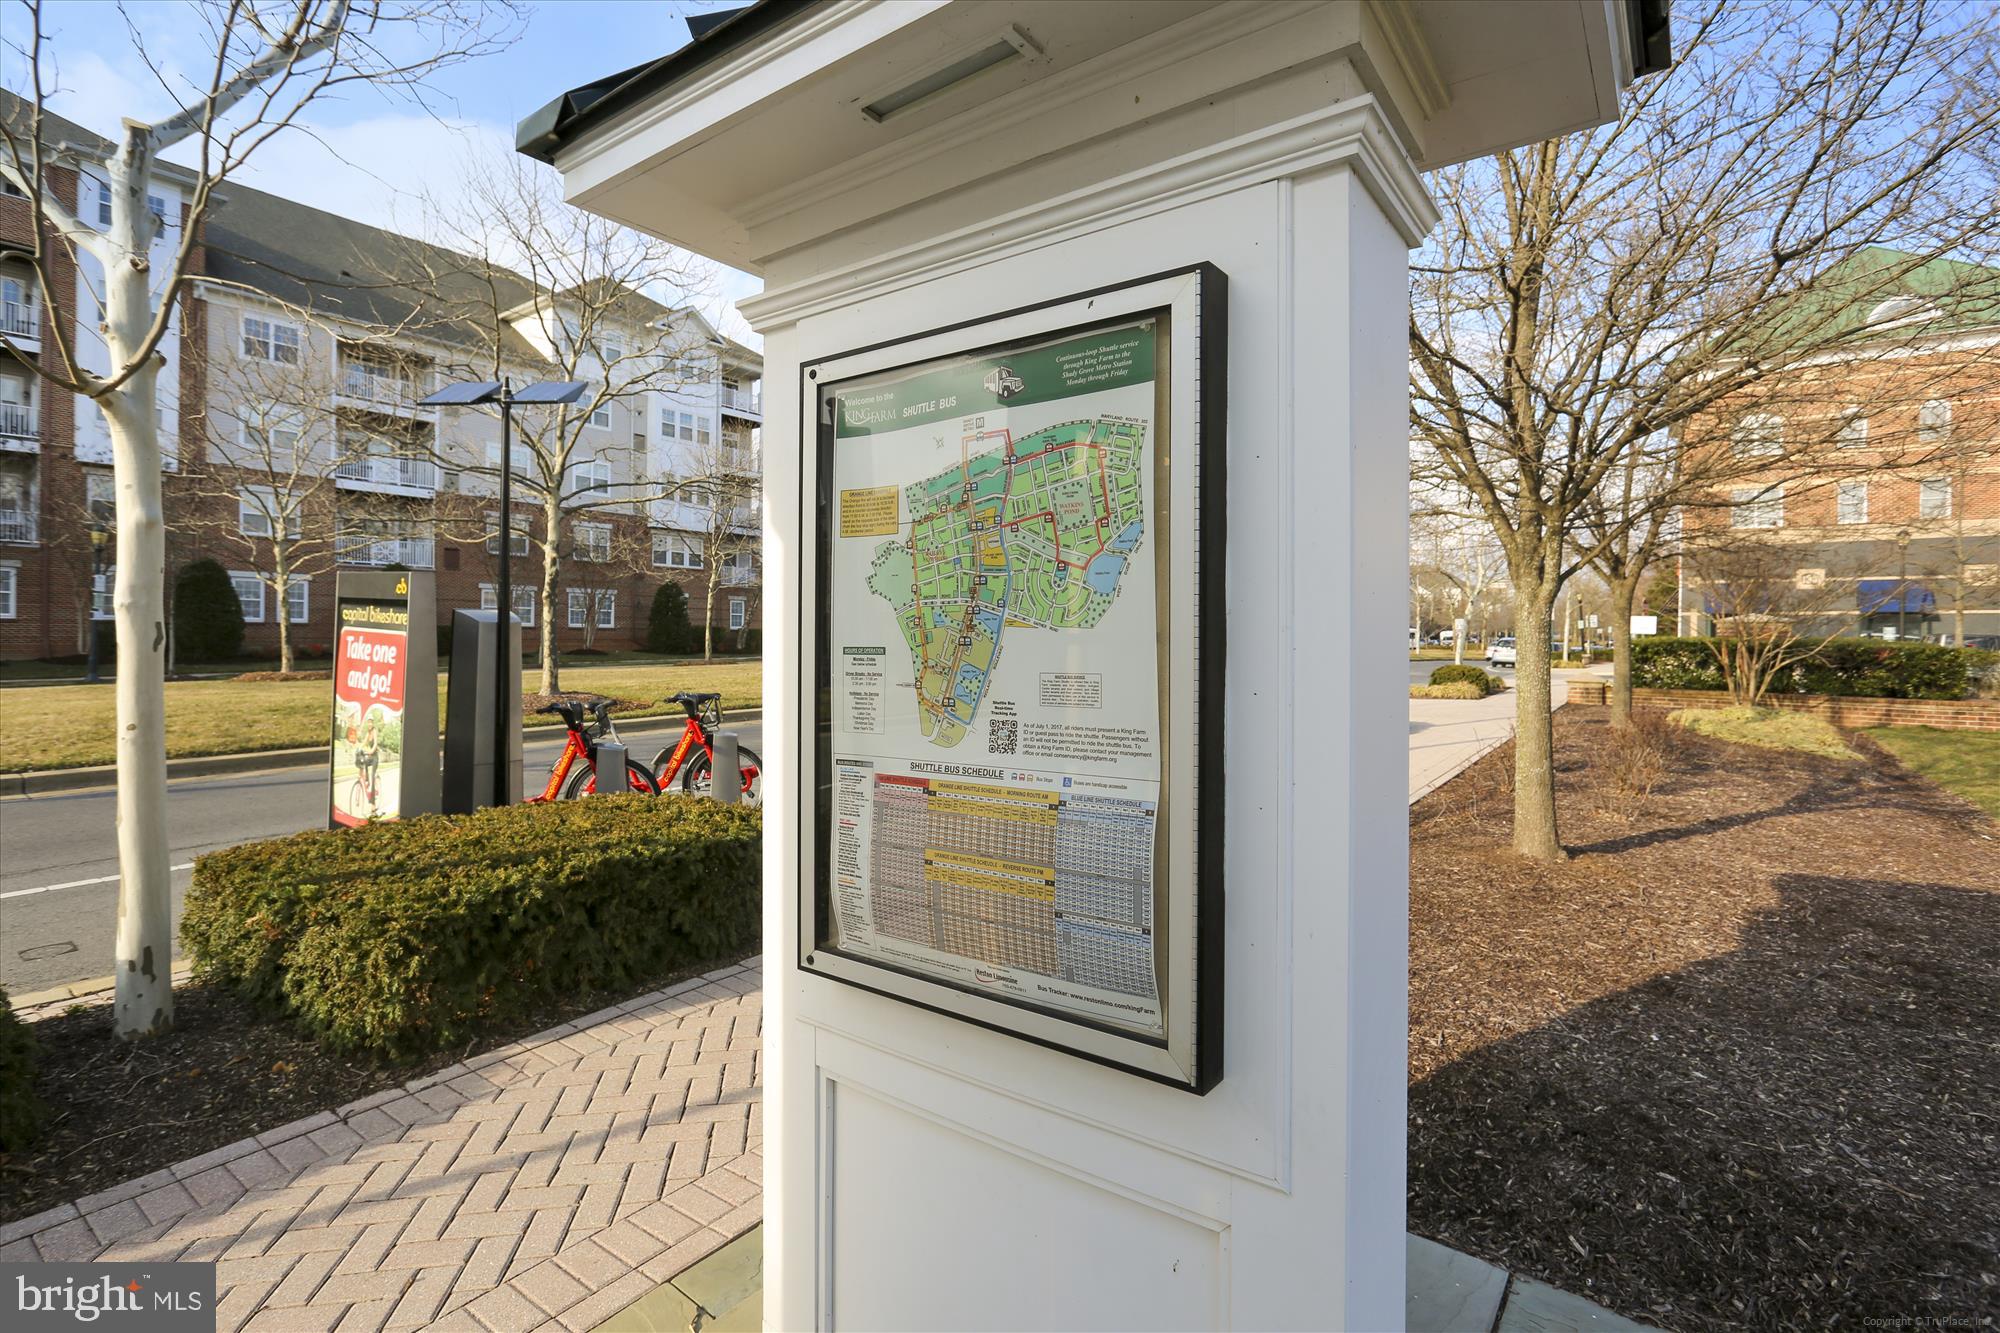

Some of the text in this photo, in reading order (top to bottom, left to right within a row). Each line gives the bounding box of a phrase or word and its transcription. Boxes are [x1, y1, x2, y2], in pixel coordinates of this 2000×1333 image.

[1120, 340, 1140, 349] service
[1062, 370, 1078, 379] Shady
[1078, 366, 1094, 374] Grove
[1112, 360, 1132, 368] Station
[1063, 361, 1084, 370] through
[1084, 358, 1098, 366] King
[1098, 354, 1114, 362] Farm
[1066, 368, 1129, 386] Monday through Friday
[844, 392, 894, 407] Welcome to the
[902, 396, 956, 418] SHUTTLE BUS
[342, 605, 408, 626] capital bikeshare
[346, 635, 397, 665] Take one
[346, 666, 392, 698] and go!
[554, 744, 576, 776] bikeshare
[910, 761, 1004, 778] SHUTTLE BUS SCHEDULE
[1007, 790, 1026, 798] MORNING
[1095, 797, 1115, 805] SHUTTLE
[1115, 798, 1142, 807] SCHEDULE
